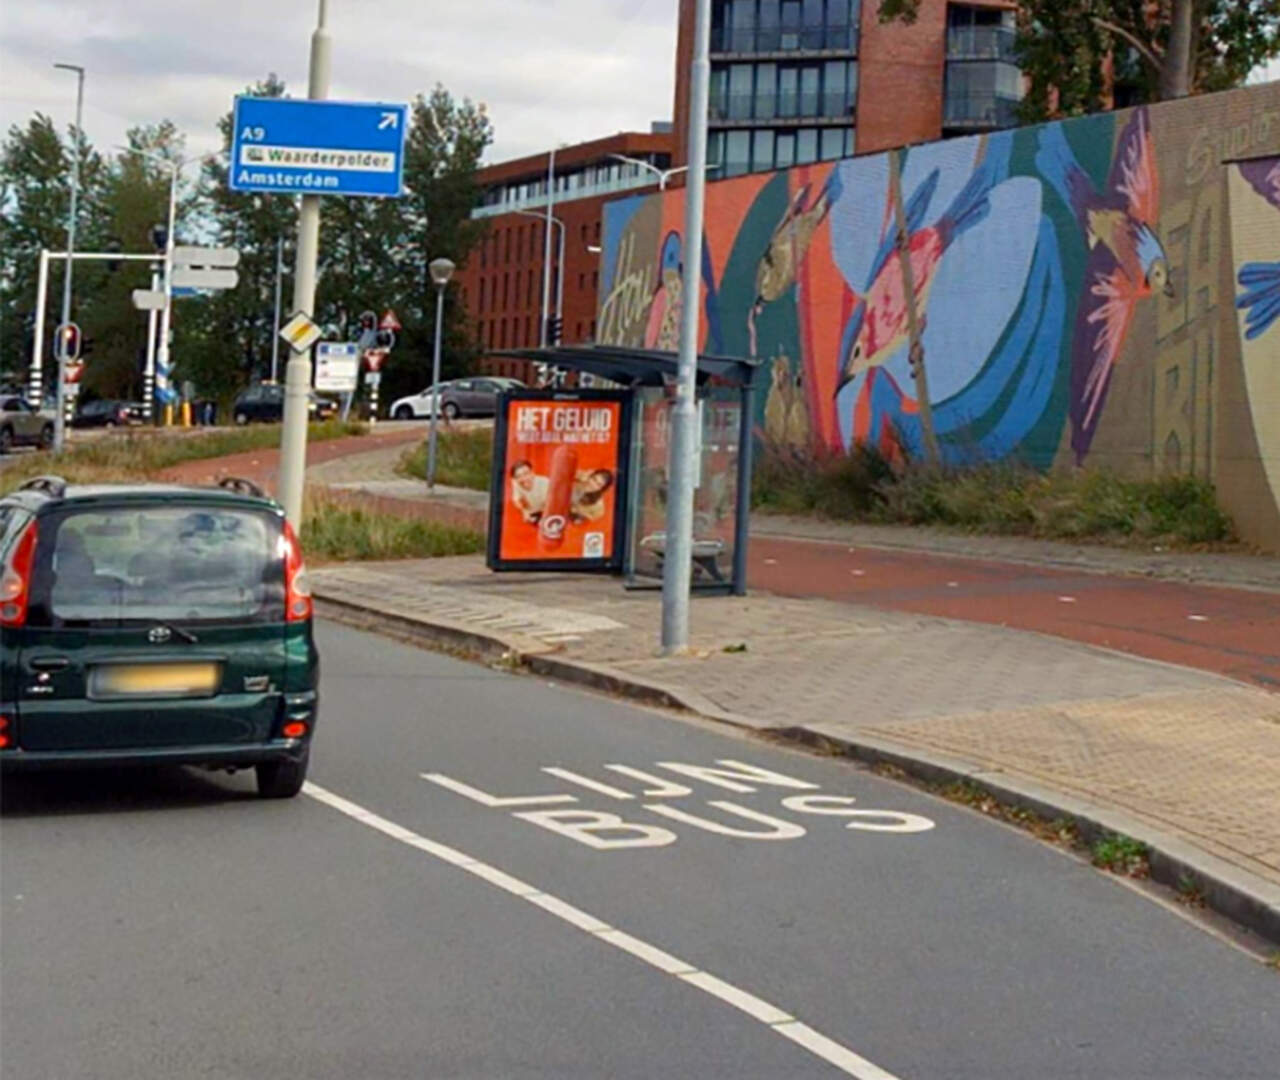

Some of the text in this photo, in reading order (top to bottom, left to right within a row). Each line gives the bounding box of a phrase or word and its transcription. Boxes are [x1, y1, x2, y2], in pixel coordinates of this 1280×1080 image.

[241, 126, 266, 141] A9
[268, 149, 390, 168] Waarderpolder
[238, 170, 340, 188] Amsterdam
[517, 406, 612, 432] HET GELUID
[420, 759, 821, 807] LIJN
[512, 796, 935, 849] BUS
